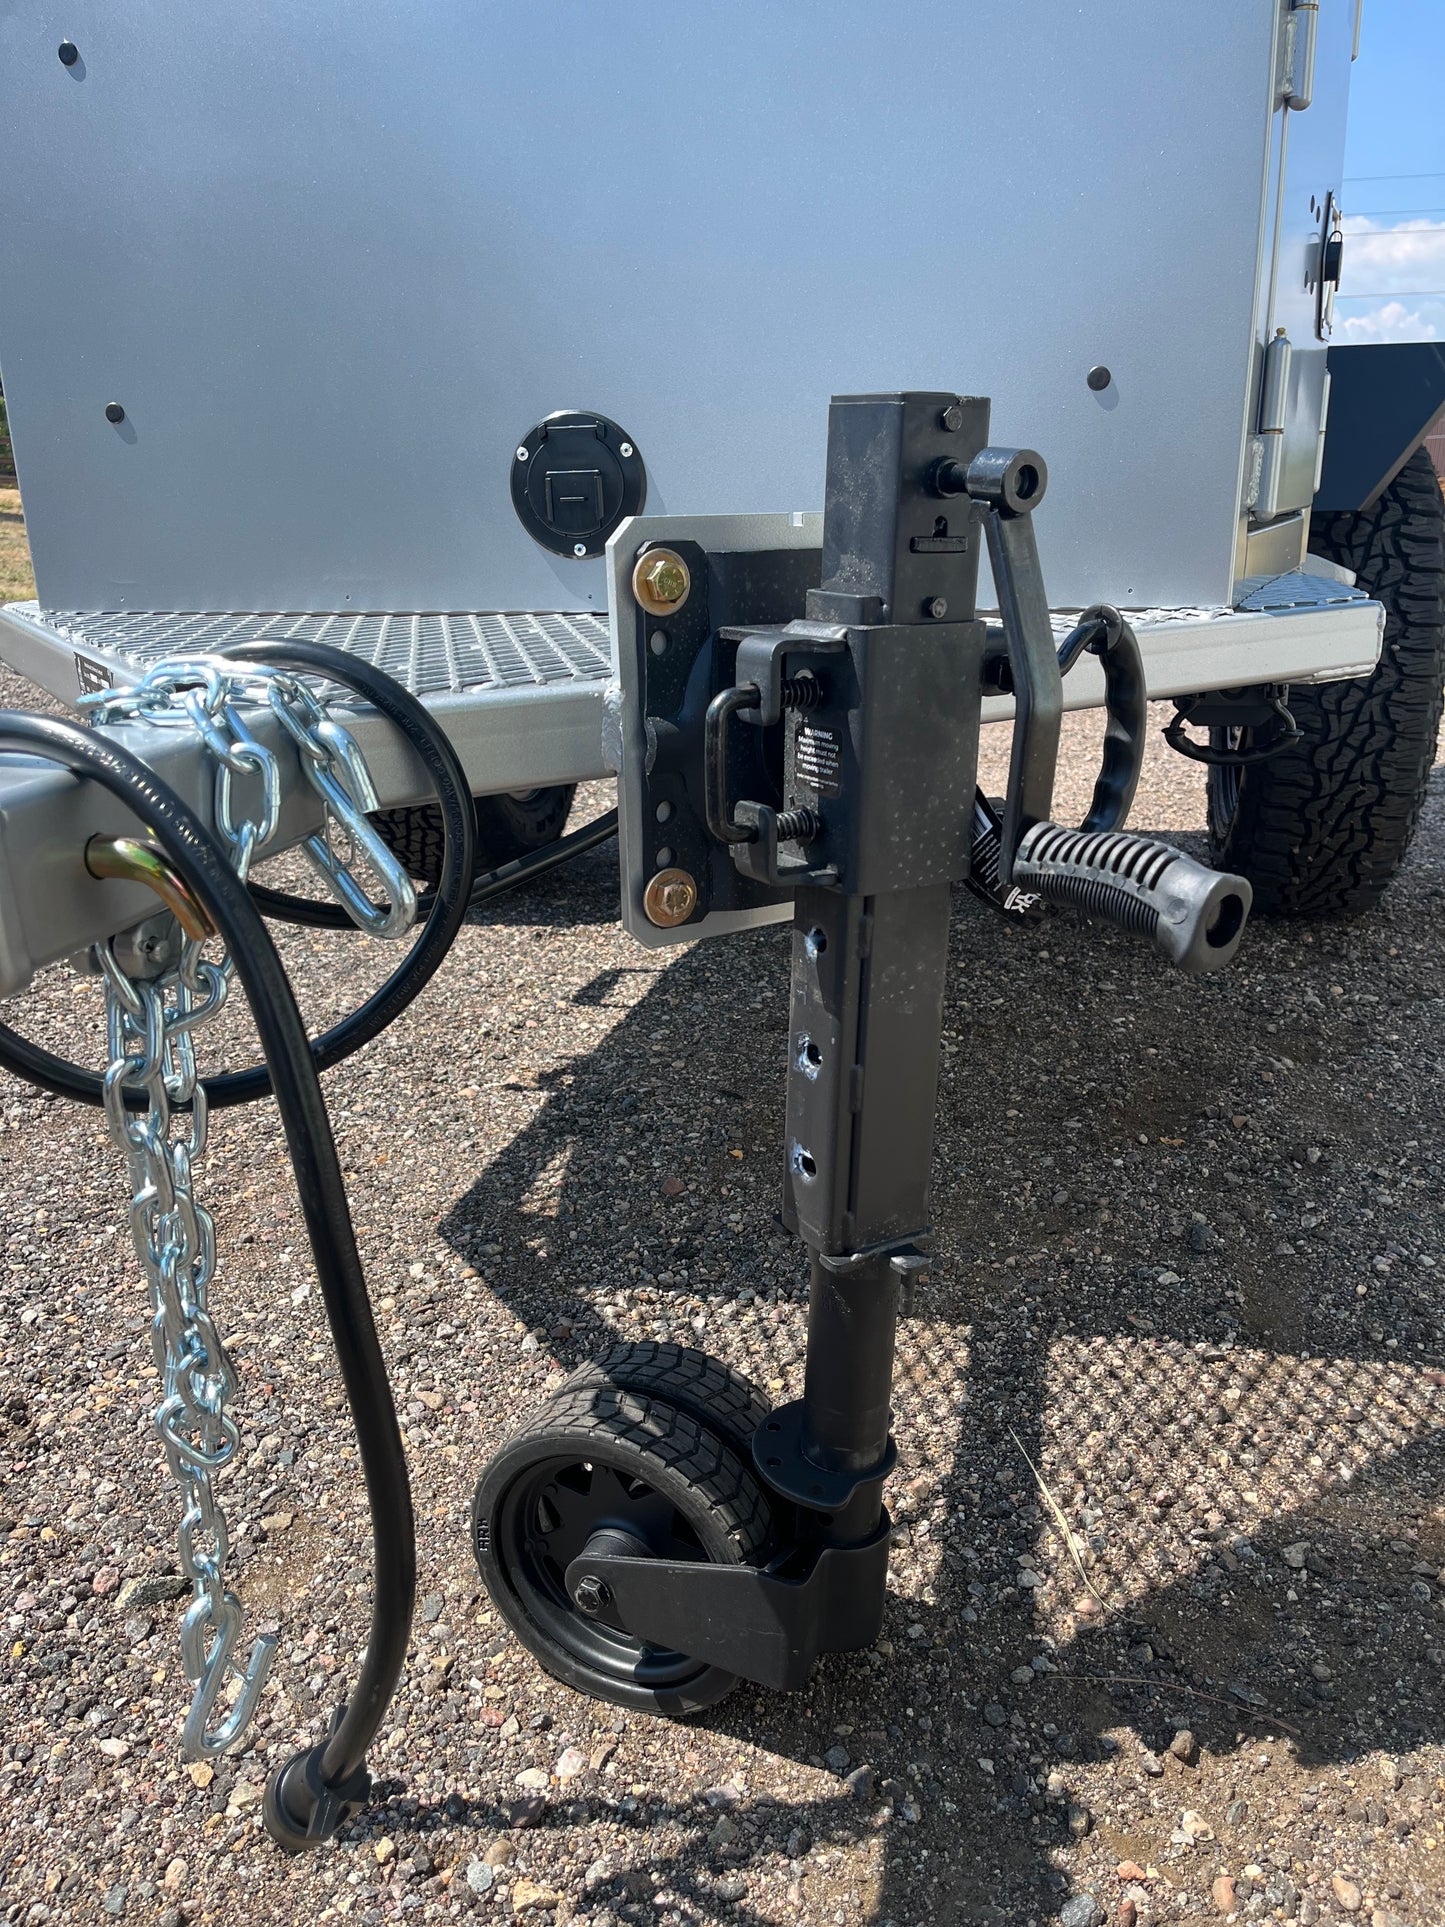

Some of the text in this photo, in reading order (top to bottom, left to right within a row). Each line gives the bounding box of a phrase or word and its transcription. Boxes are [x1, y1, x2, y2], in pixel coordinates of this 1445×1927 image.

[804, 727, 833, 740] WARNING
[800, 744, 816, 754] height
[815, 749, 828, 757] must
[820, 741, 839, 752] moving
[797, 752, 839, 768] be exceeded when
[802, 763, 833, 775] moving trailer
